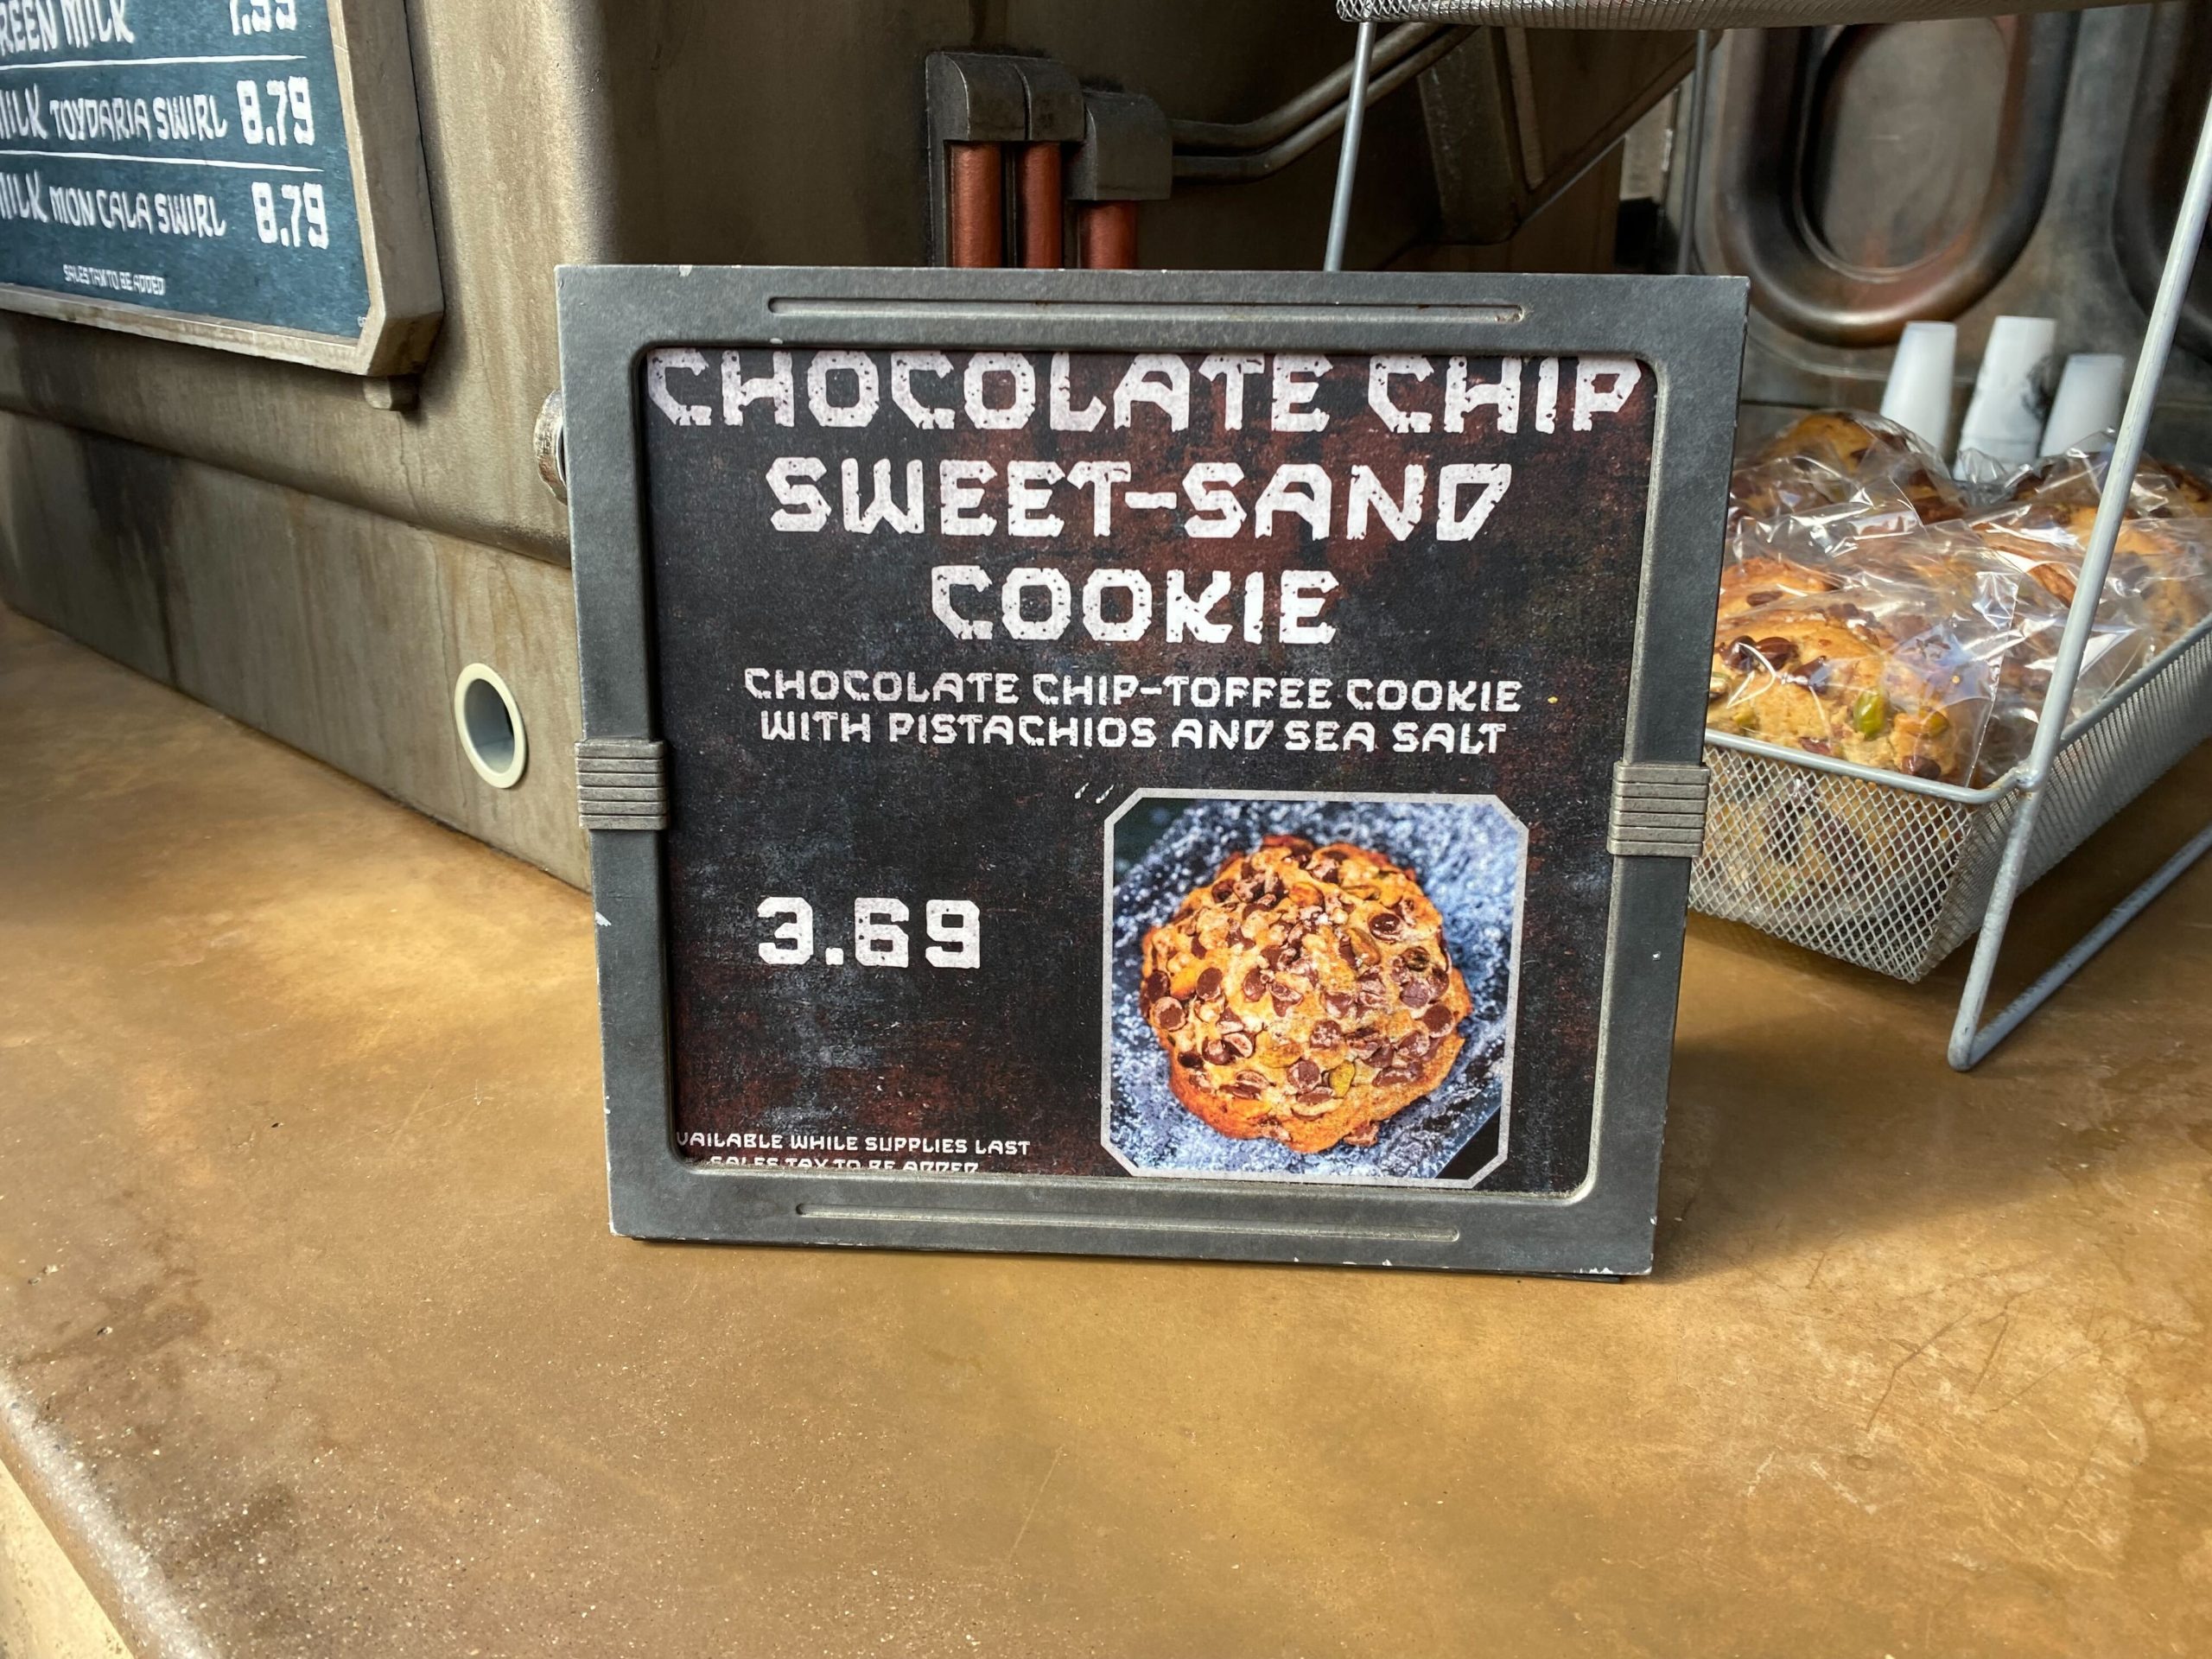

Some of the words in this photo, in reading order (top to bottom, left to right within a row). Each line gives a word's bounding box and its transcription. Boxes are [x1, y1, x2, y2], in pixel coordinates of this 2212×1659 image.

[60, 0, 135, 48] MILK
[49, 98, 151, 142] TOYDARIA
[153, 94, 227, 141] SWIRL
[237, 76, 315, 146] 8.79
[49, 186, 94, 226] MON
[96, 189, 153, 234] CALA
[155, 194, 226, 238] SWIRL
[251, 182, 329, 250] 8.79
[63, 264, 91, 285] SALES
[132, 274, 166, 296] ADDED
[648, 348, 1333, 433] CHOCOLATE
[1368, 355, 1641, 434] CHIP
[766, 457, 1512, 542] SWEET-SAND
[931, 565, 1338, 645] COOKIE
[744, 667, 1020, 704] CHOCOLATE
[1033, 673, 1333, 710] CHIP-TOFFEE
[1346, 678, 1522, 712] COOKIE
[761, 710, 870, 743] WITH
[888, 713, 1156, 748] PISTACHIOS
[1172, 718, 1274, 750] AND
[1285, 721, 1376, 753] SEA
[1392, 721, 1506, 754] SALT
[757, 897, 980, 969] 3.69
[790, 1135, 858, 1151] WHILE
[865, 1136, 968, 1154] SUPPLIES
[975, 1139, 1031, 1155] LAST
